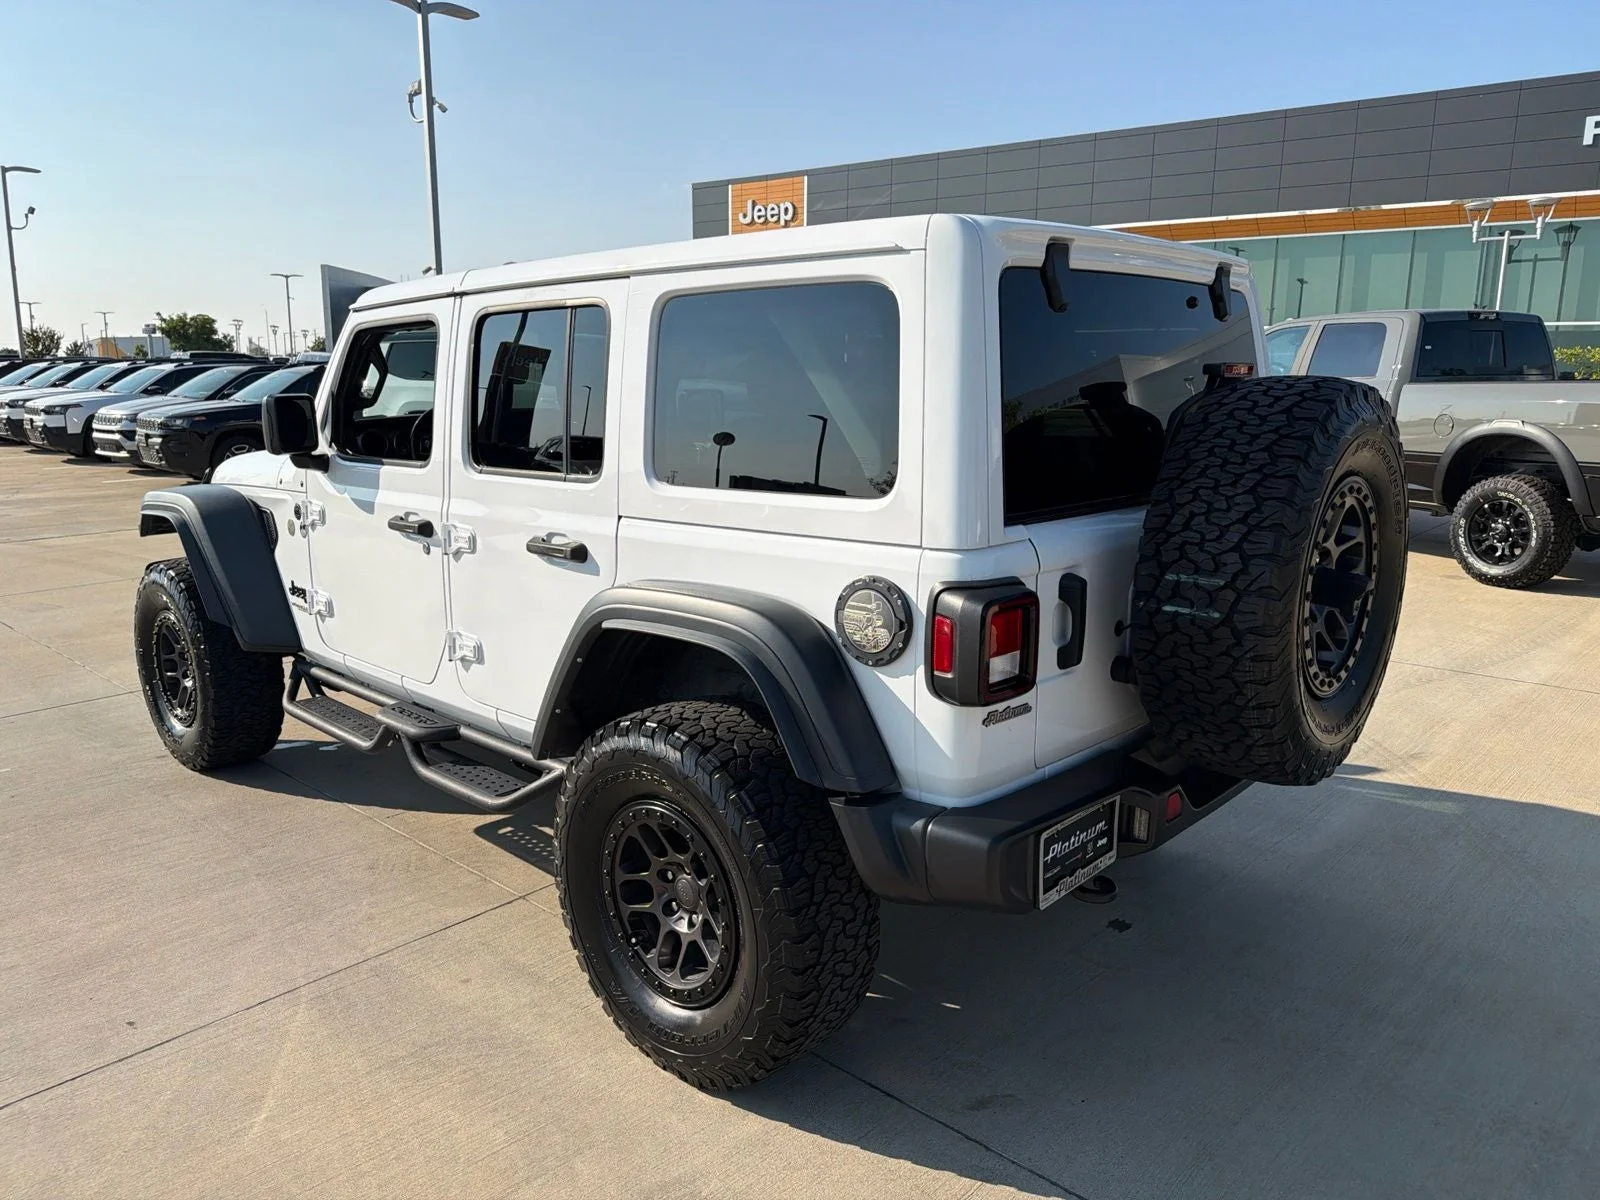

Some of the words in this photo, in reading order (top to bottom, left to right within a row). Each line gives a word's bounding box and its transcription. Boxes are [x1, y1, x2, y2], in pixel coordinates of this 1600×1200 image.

[738, 199, 796, 227] Jeep
[289, 580, 307, 604] Jeep
[1043, 820, 1109, 864] Platinum
